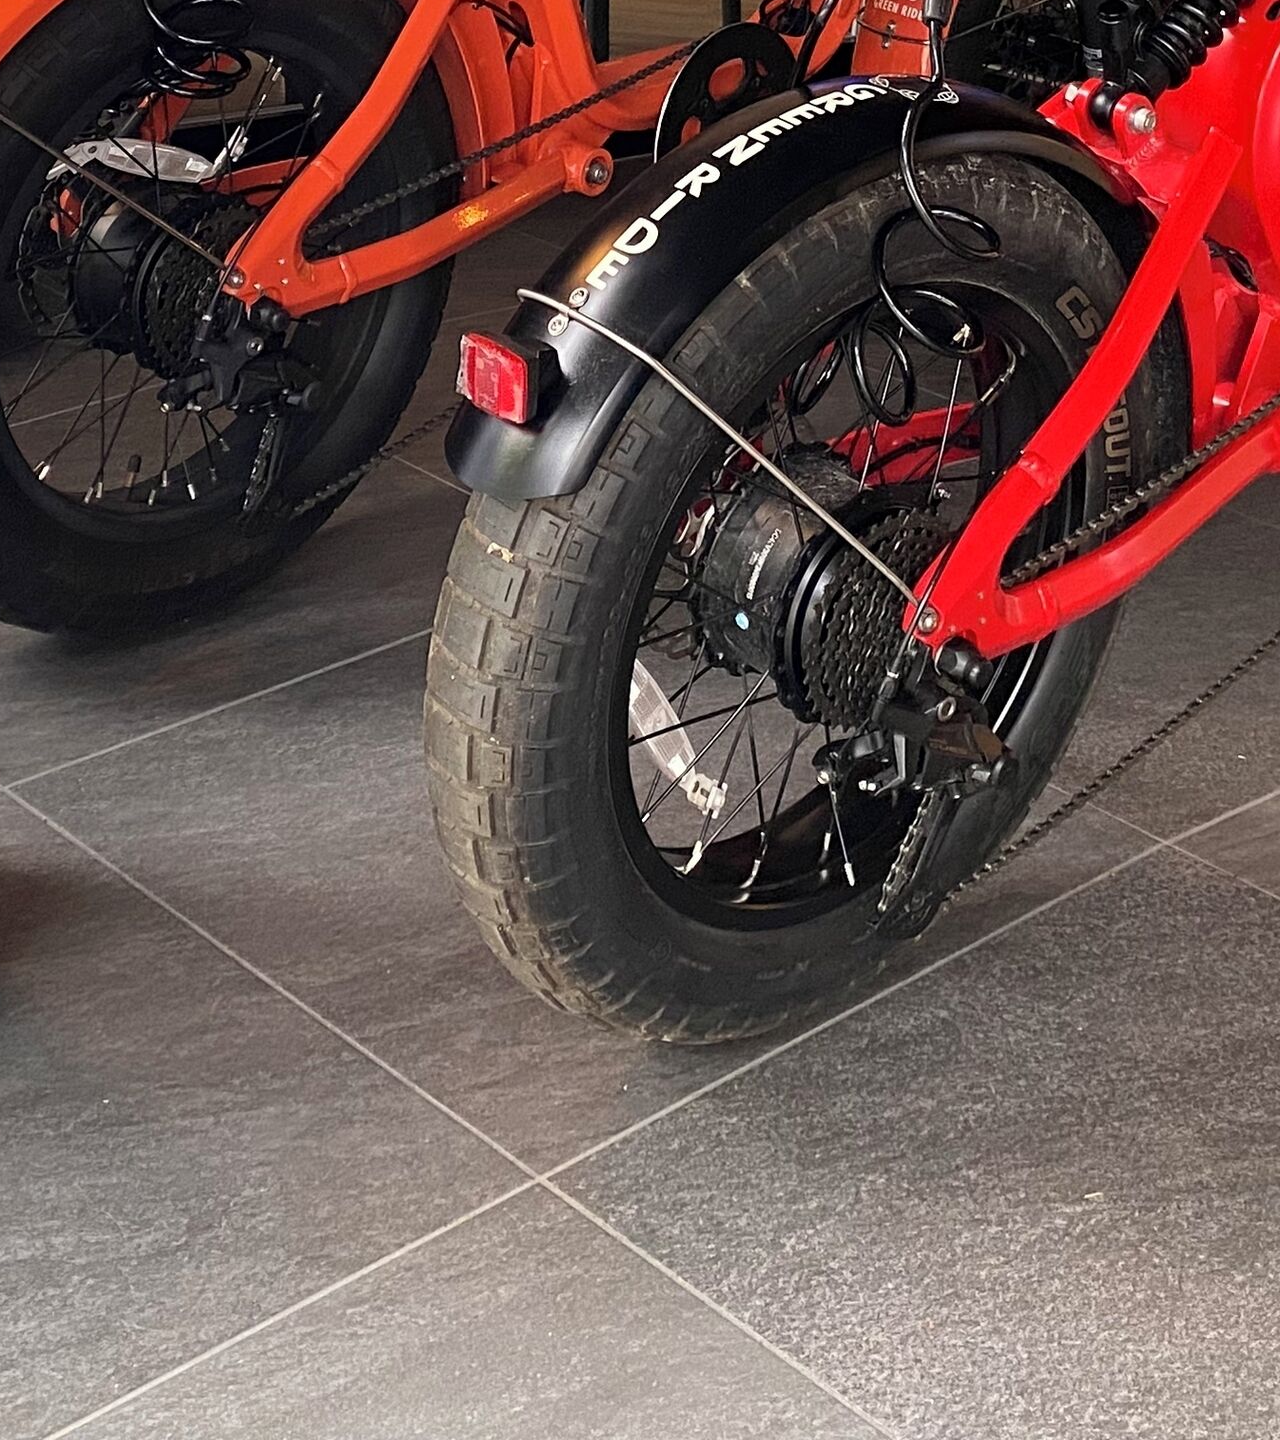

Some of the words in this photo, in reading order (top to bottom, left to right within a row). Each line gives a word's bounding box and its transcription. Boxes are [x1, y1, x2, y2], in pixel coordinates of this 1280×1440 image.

[712, 83, 888, 167] GREEN
[586, 161, 720, 291] RIDE
[1055, 285, 1106, 356] CS
